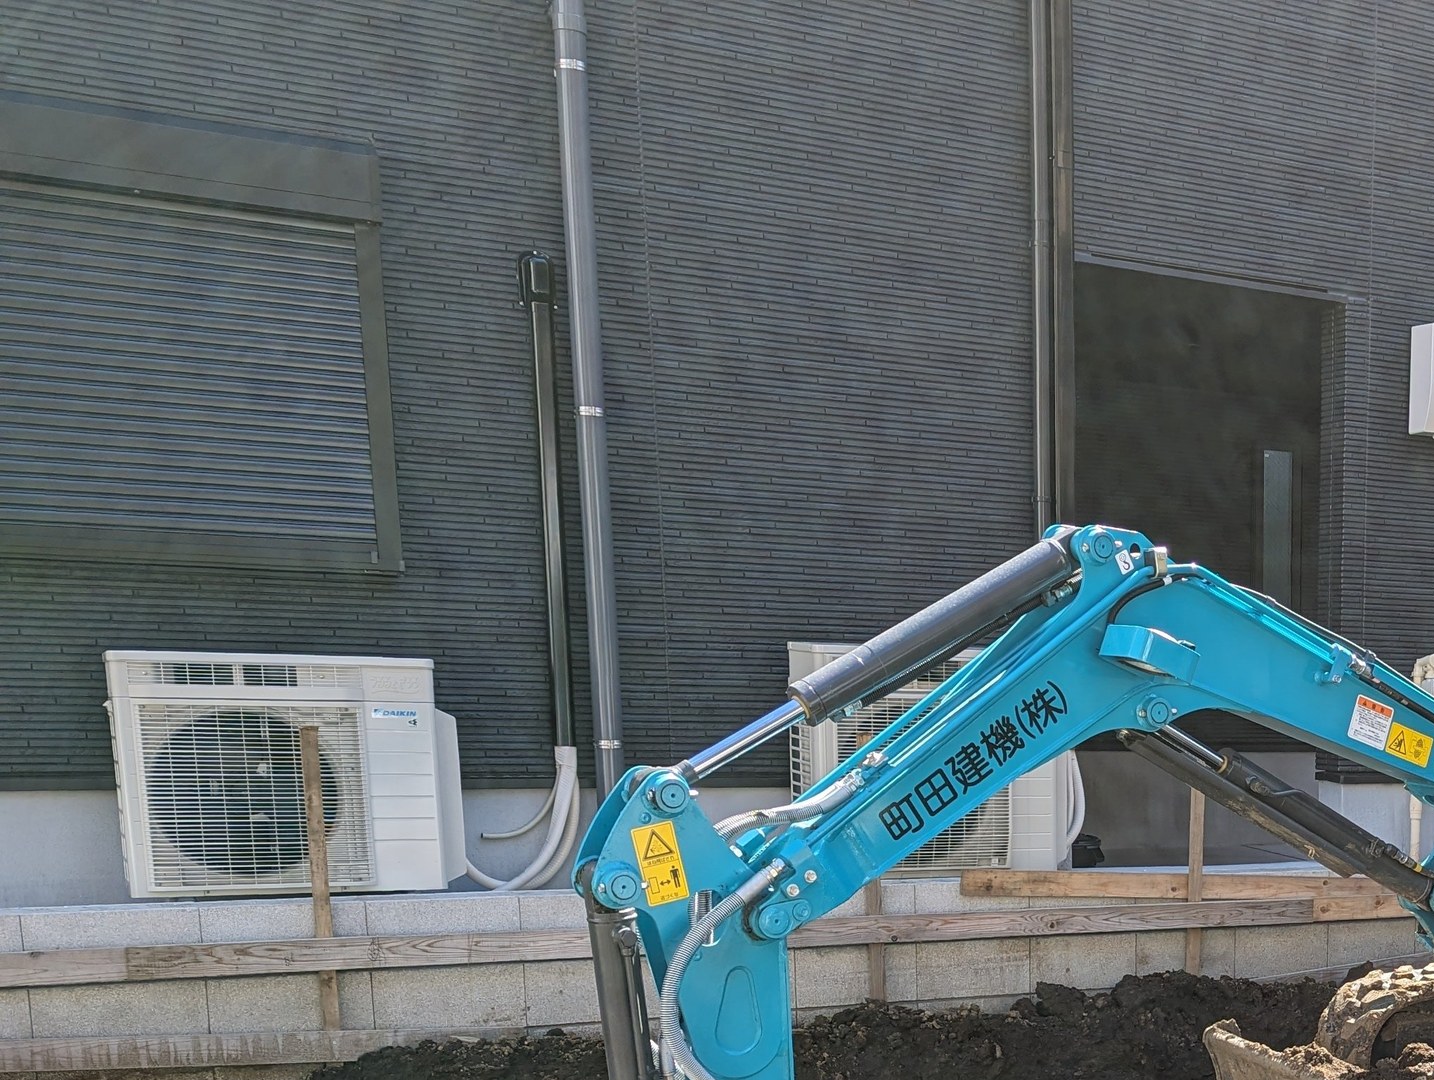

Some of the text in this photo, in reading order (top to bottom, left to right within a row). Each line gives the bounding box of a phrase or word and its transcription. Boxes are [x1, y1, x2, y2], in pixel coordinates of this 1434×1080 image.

[879, 681, 1068, 840] 町田建機(株)
